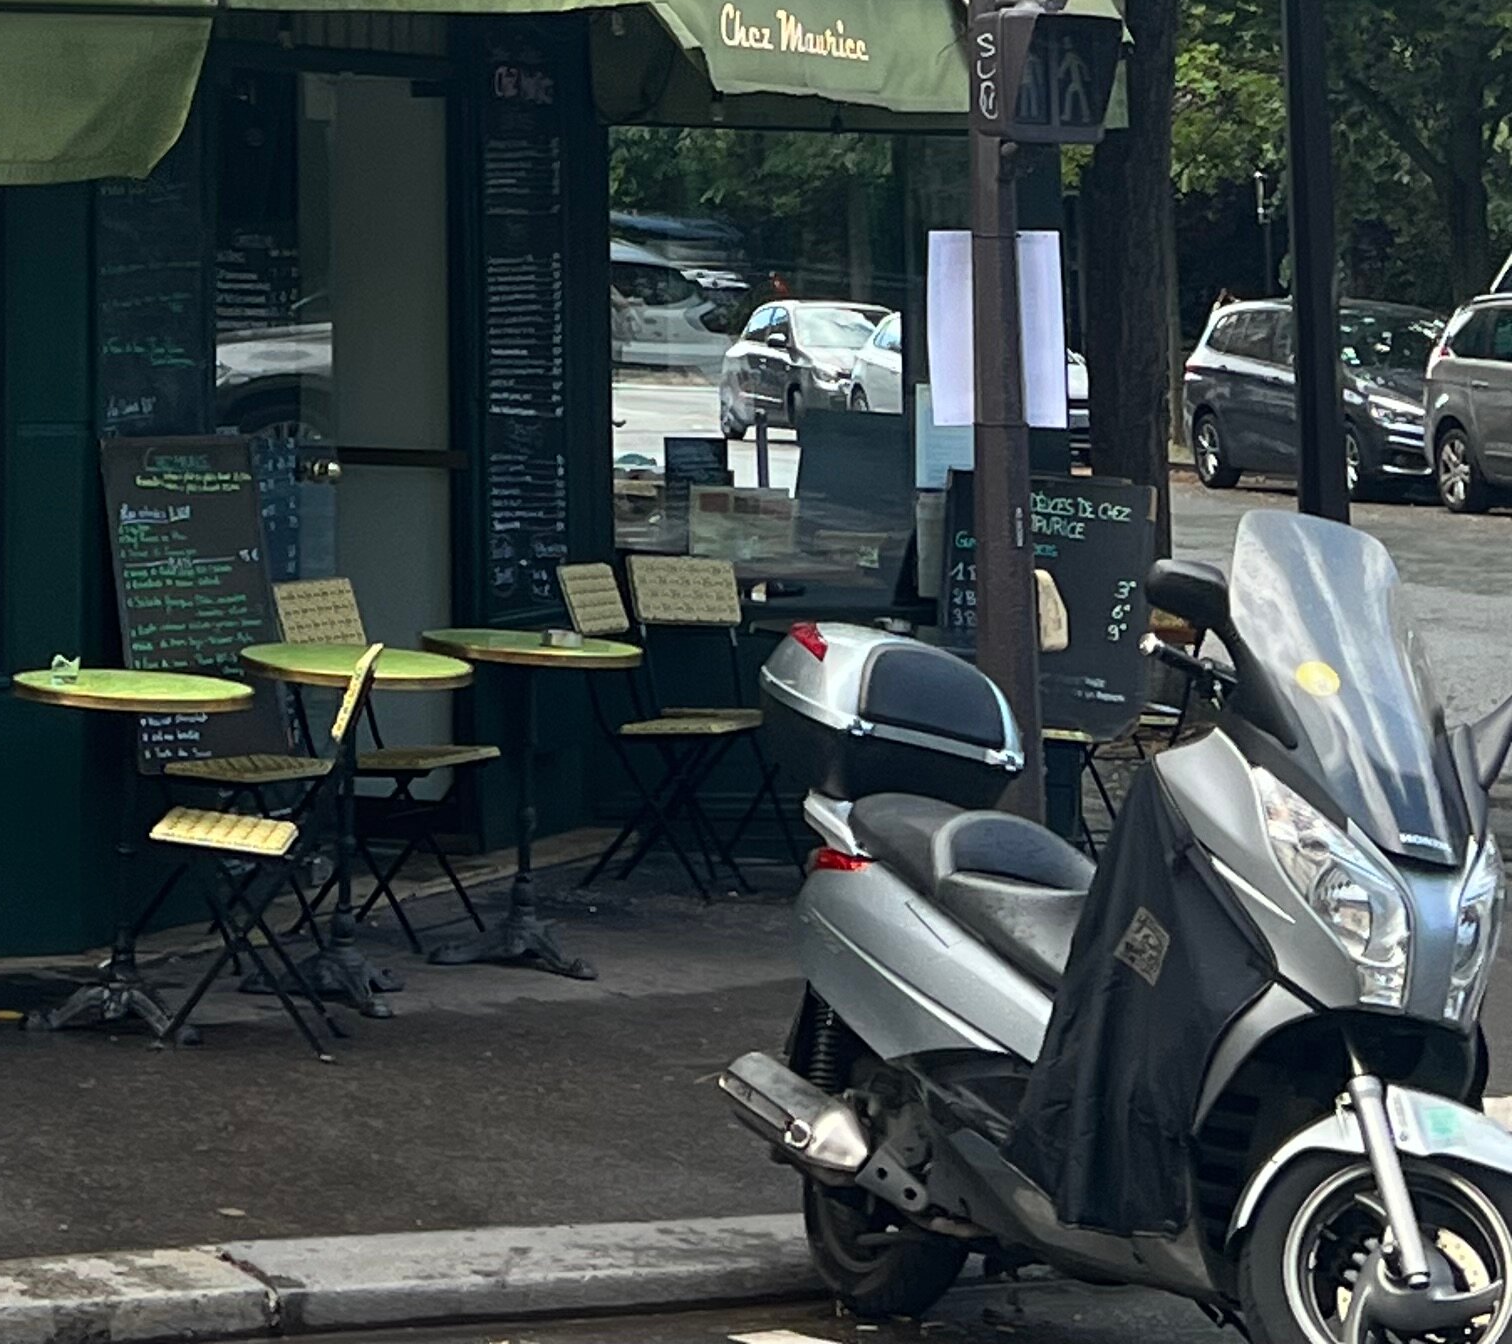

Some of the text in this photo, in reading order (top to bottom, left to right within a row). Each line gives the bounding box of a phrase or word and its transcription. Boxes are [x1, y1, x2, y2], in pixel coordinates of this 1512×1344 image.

[720, 2, 870, 62] Chez Maurice
[1076, 496, 1096, 519] DE
[1097, 501, 1134, 523] CHEZ
